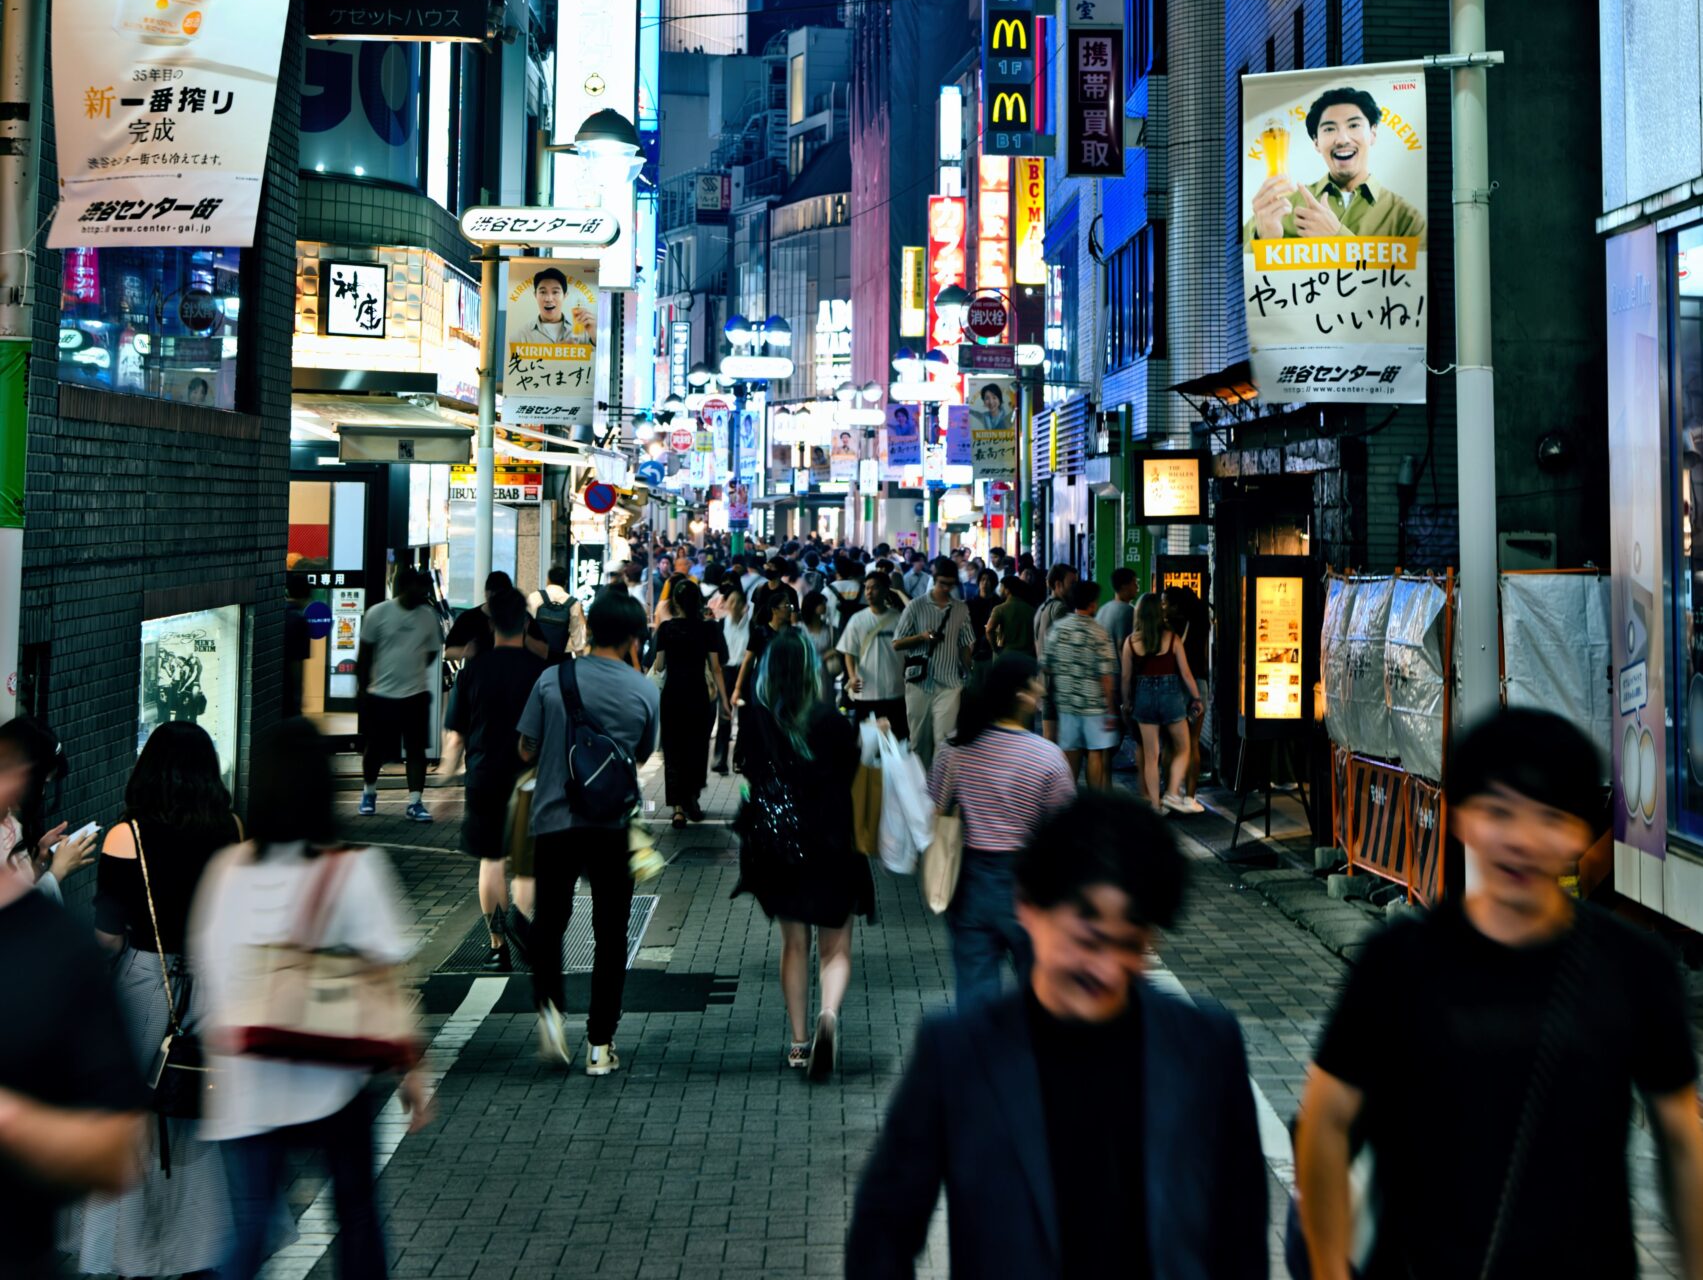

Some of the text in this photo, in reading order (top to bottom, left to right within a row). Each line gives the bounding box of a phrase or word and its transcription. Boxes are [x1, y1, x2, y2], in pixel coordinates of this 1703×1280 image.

[132, 69, 184, 82] 35年目の
[1393, 83, 1416, 91] KIRIN
[84, 85, 234, 119] 新一番搾り
[1082, 41, 1109, 167] 携帯買取
[129, 117, 176, 144] 完成
[78, 197, 223, 222] 渋谷センター街
[470, 216, 604, 234] 渋谷センター街
[1265, 241, 1408, 265] KIRIN BEER
[970, 308, 1006, 327] 消火栓
[516, 345, 587, 358] KIRIN BEER
[1277, 364, 1402, 384] 渋谷センター街
[516, 405, 581, 416] 渋谷センター街
